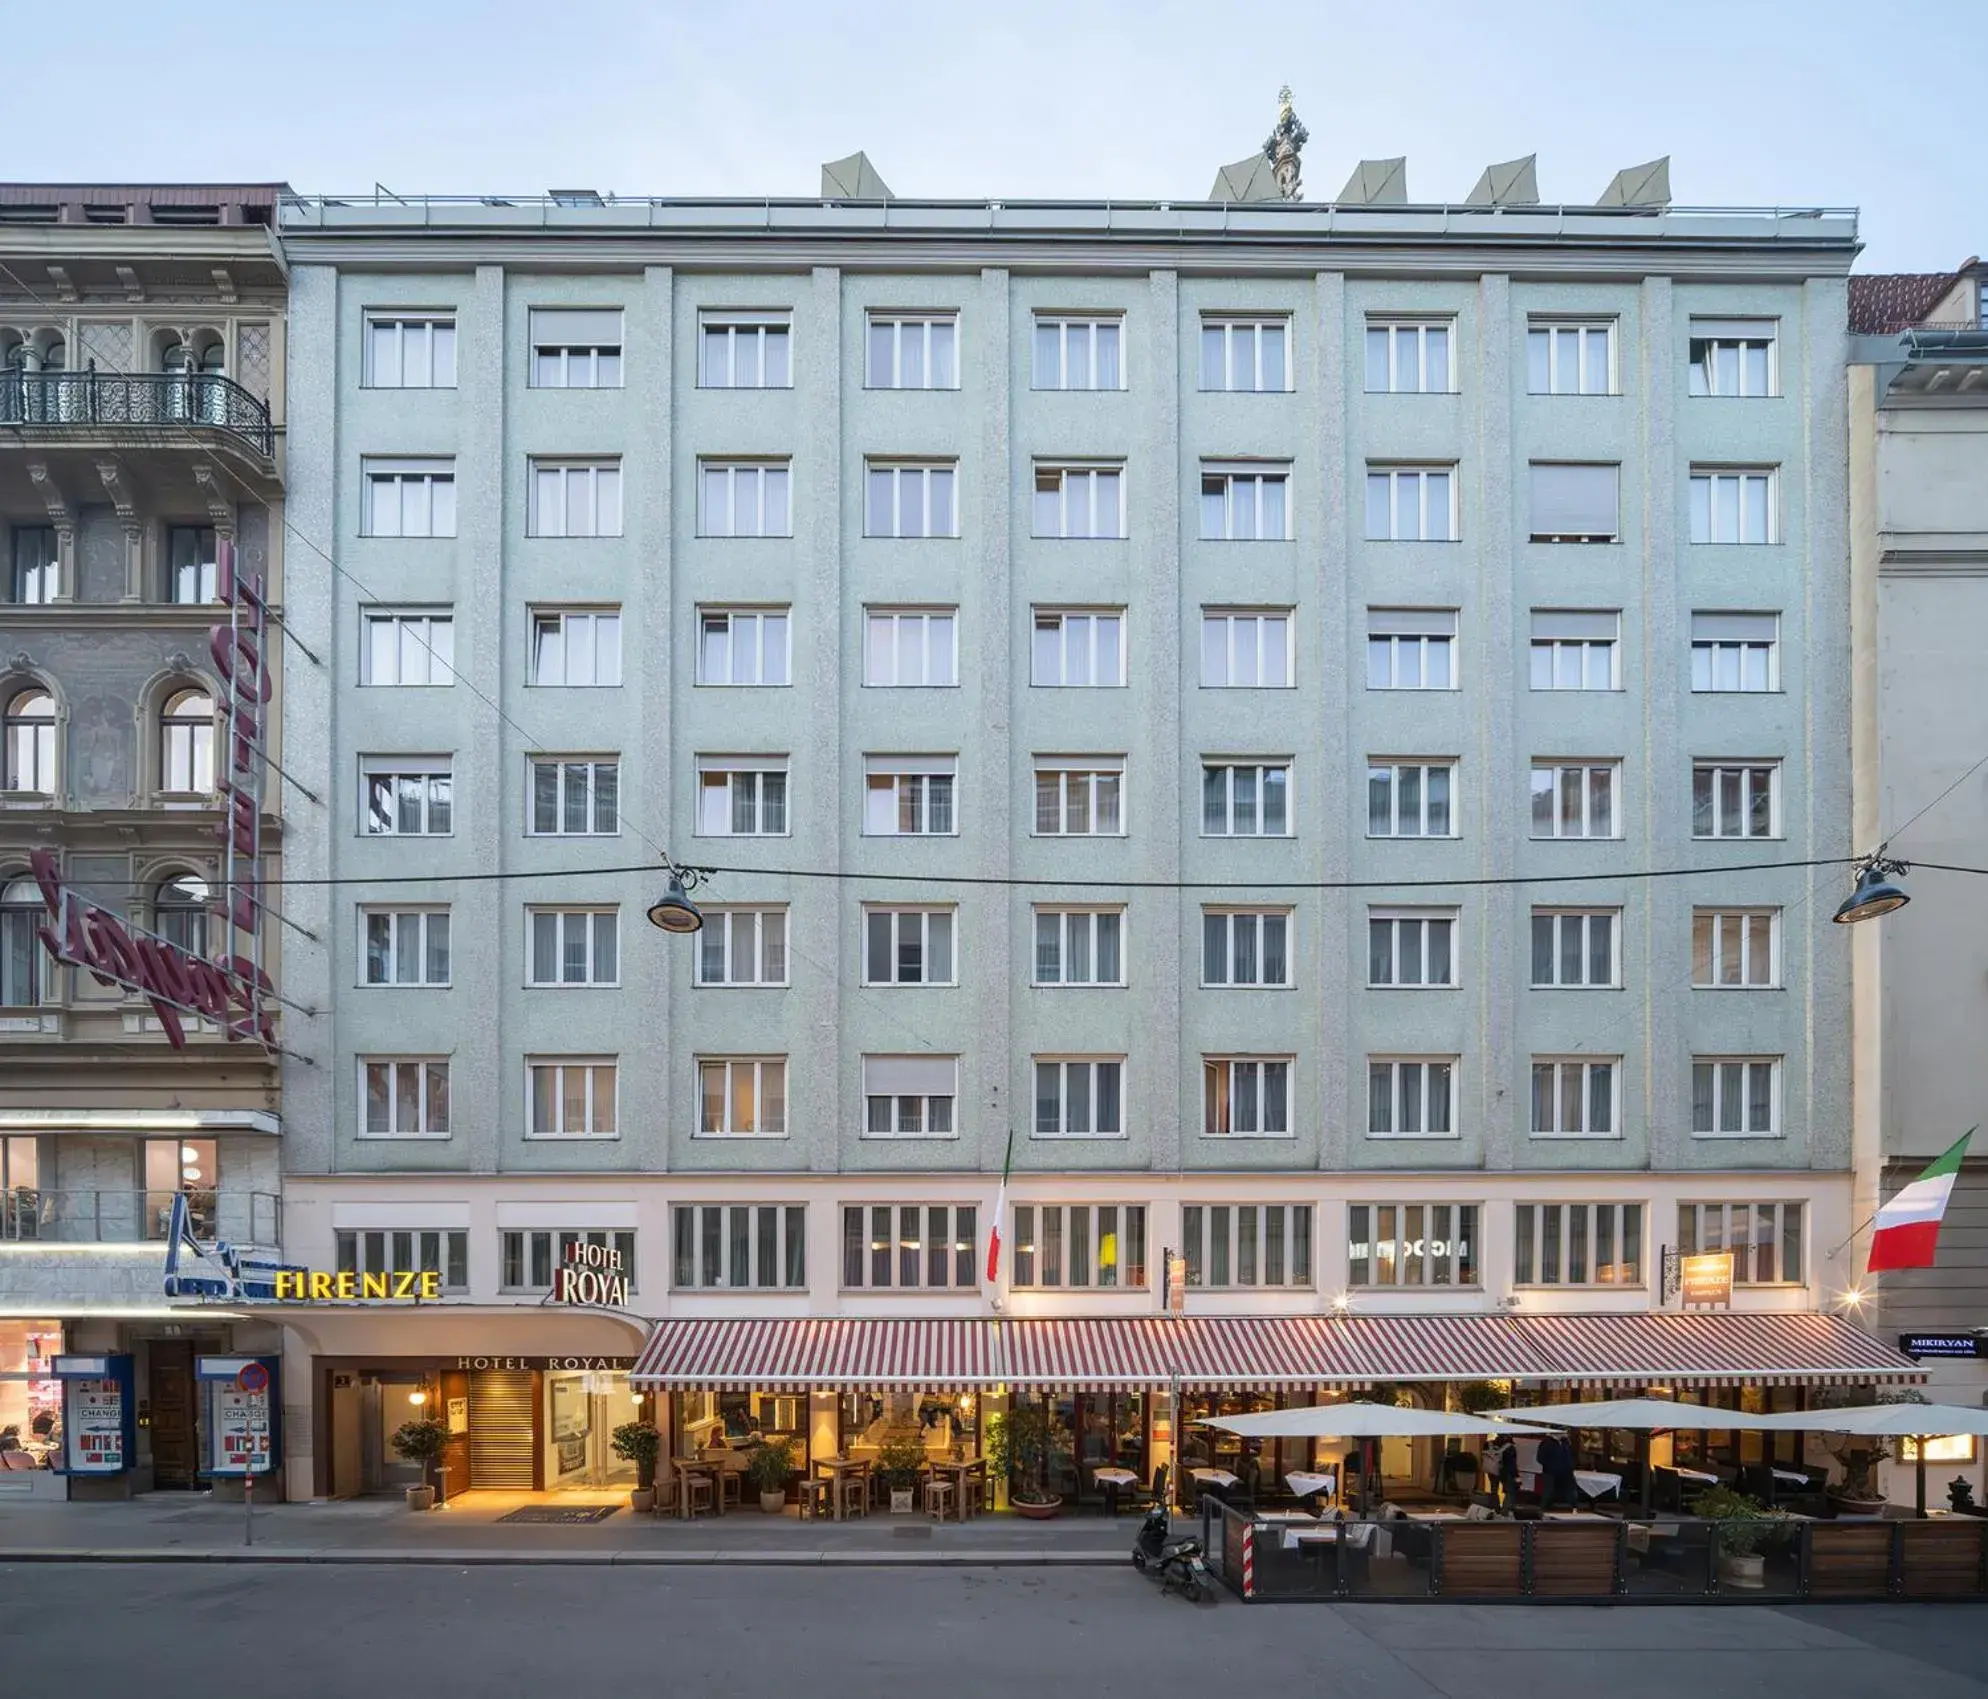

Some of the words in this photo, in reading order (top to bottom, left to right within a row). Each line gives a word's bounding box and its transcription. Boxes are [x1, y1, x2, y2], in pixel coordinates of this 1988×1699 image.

[574, 1241, 624, 1271] HOTEL
[273, 1271, 440, 1299] FIRENZE
[1911, 1339, 1975, 1348] MIKIRYAN
[457, 1357, 530, 1371] HOTEL
[549, 1357, 622, 1371] ROYAL
